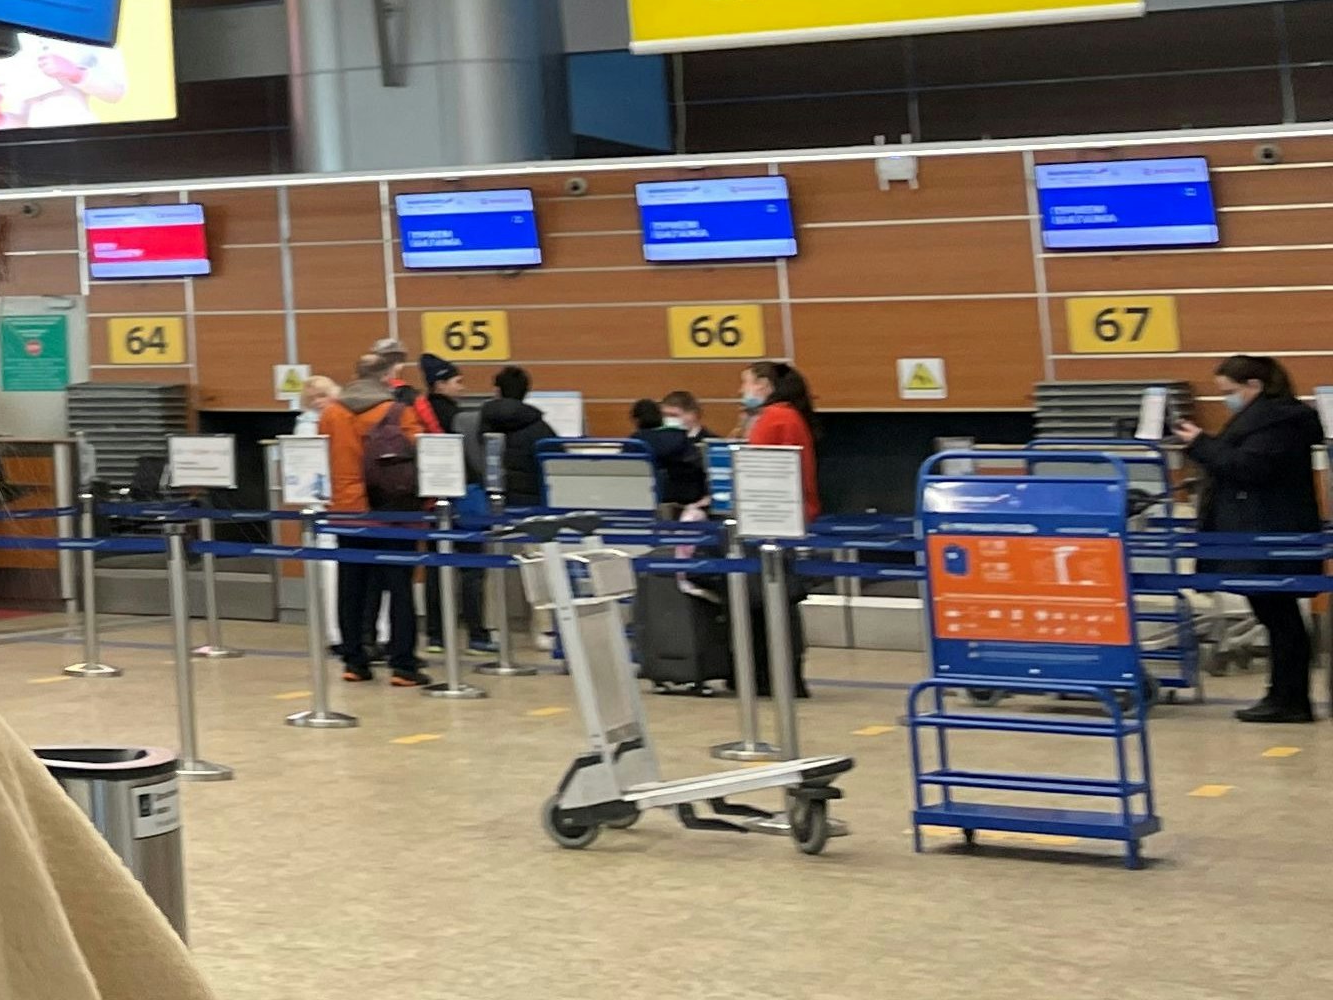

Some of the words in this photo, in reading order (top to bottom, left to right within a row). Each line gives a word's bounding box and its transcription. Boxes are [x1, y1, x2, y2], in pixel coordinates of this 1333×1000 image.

[125, 326, 167, 354] 64
[445, 320, 491, 351] 65
[691, 314, 741, 347] 66
[1094, 307, 1152, 342] 67
